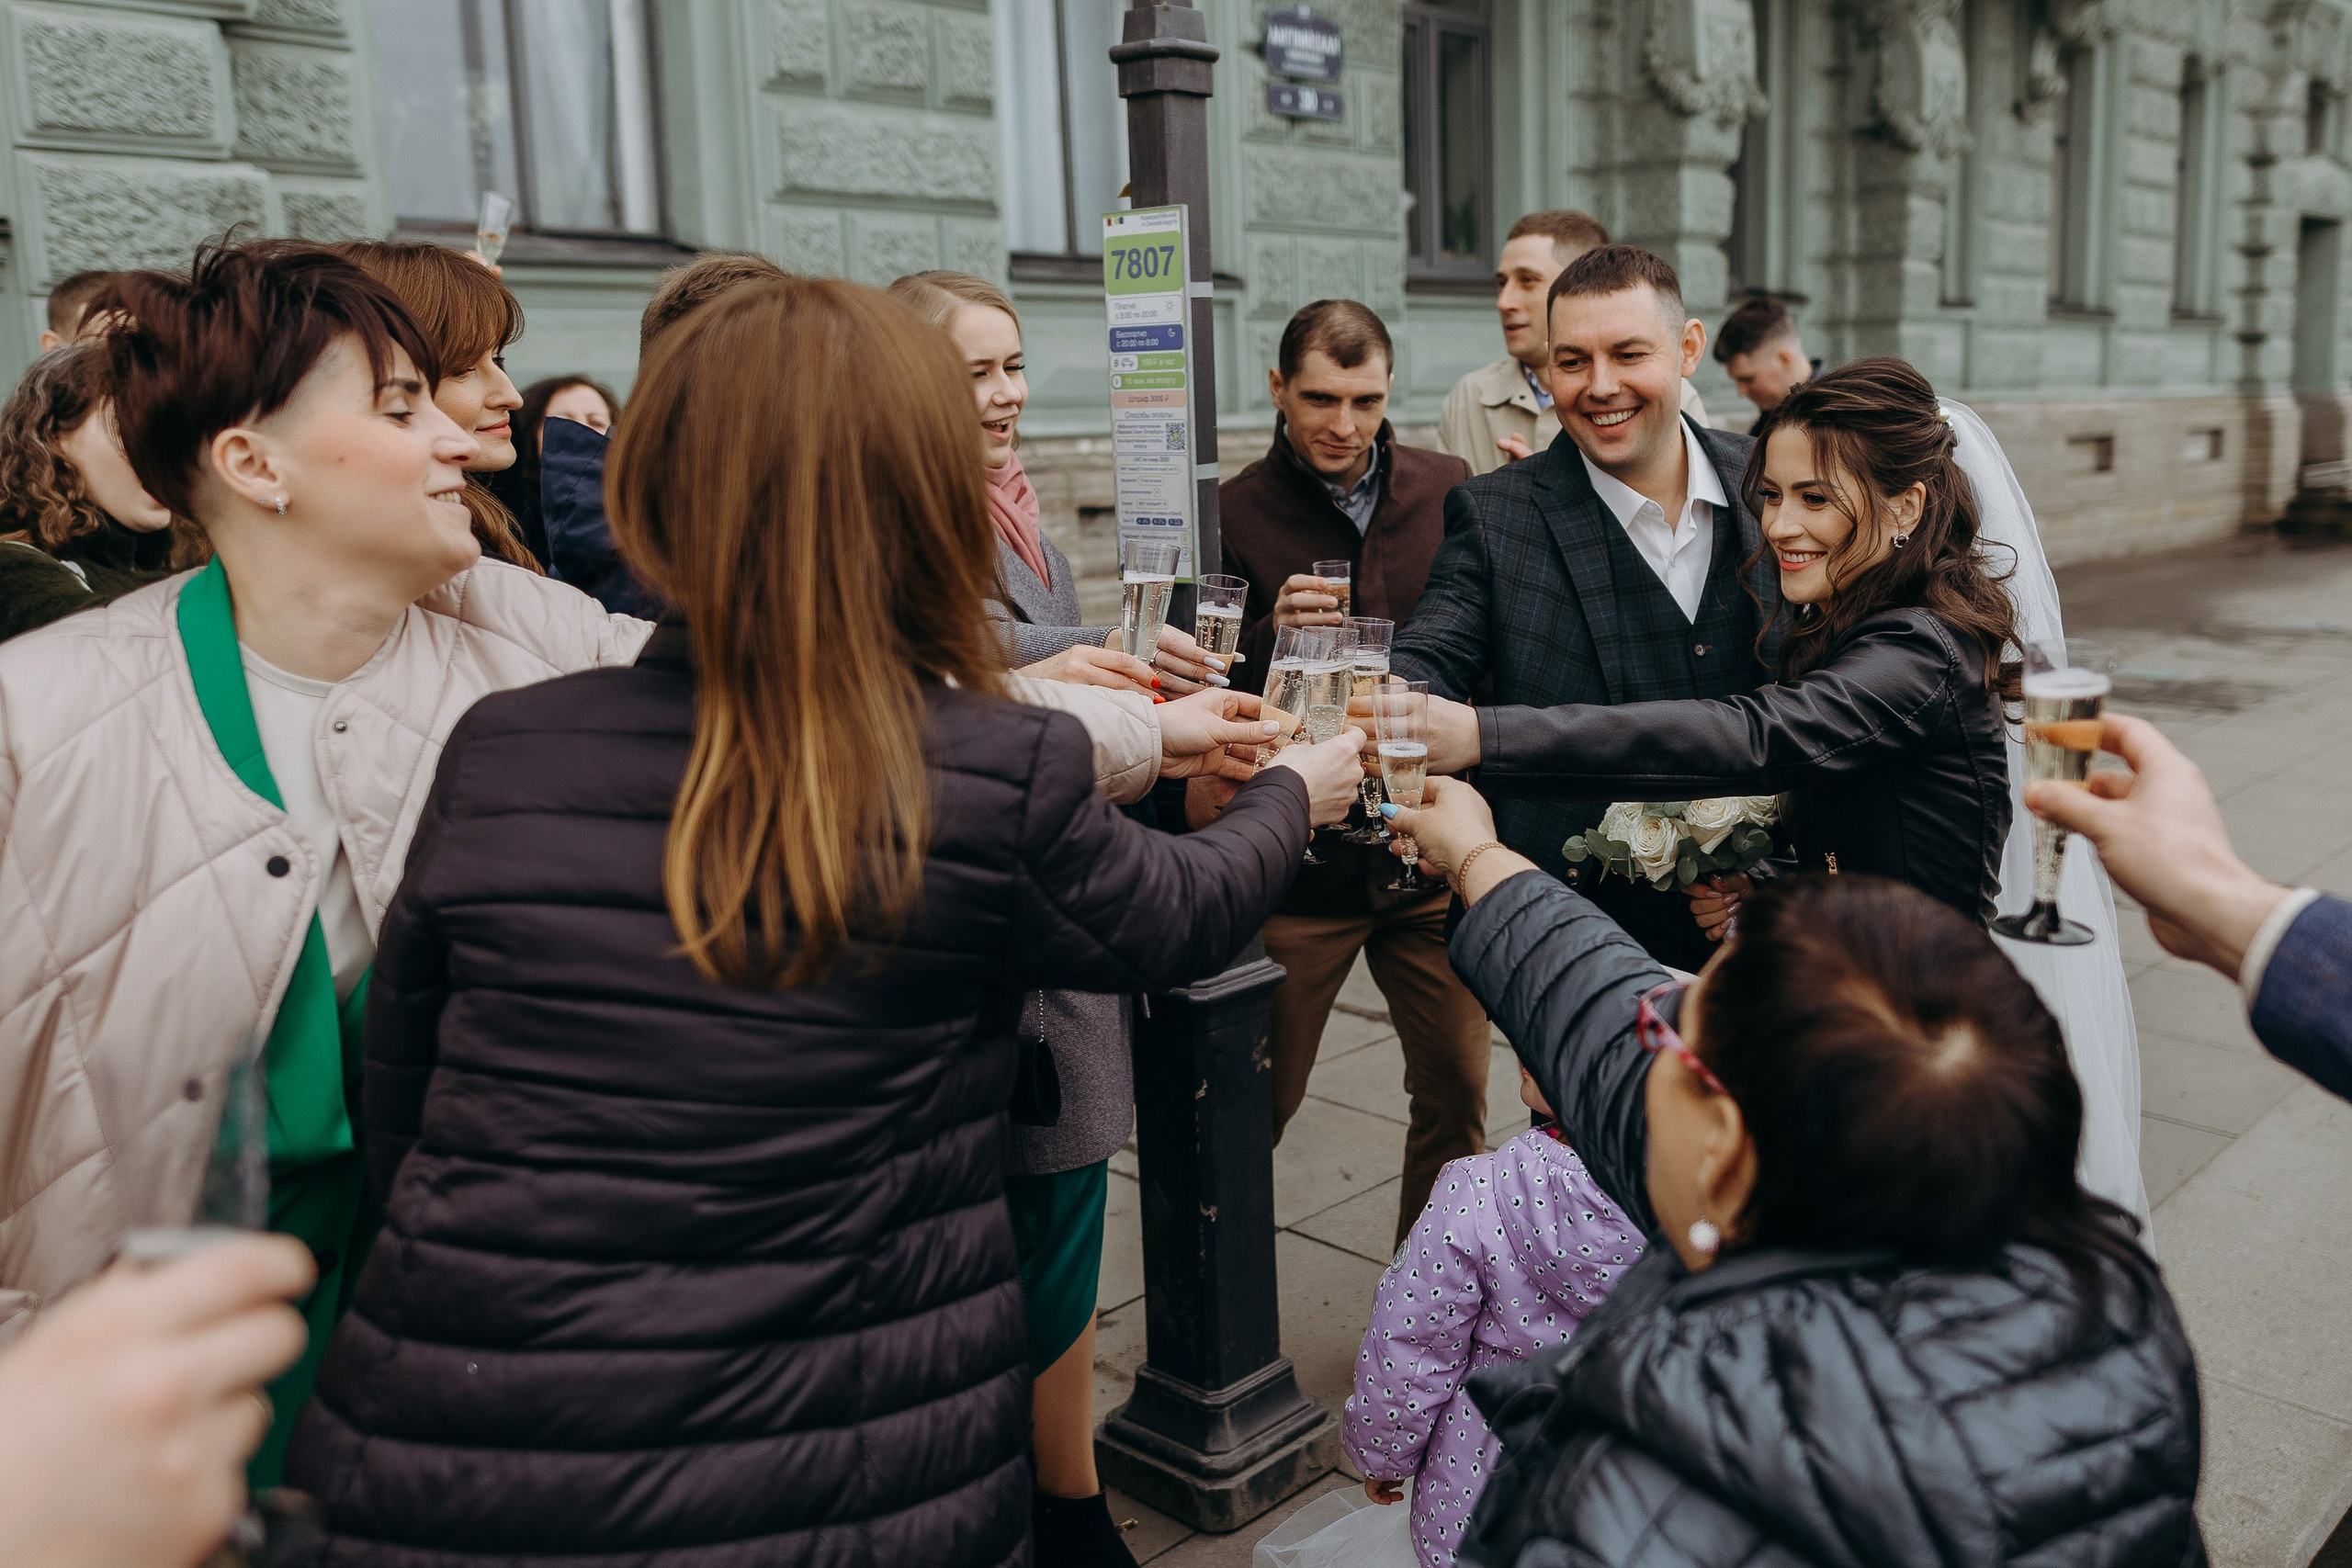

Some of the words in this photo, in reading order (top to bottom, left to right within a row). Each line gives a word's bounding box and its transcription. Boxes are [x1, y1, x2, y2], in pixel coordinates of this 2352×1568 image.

[1111, 245, 1175, 280] 7807
[1114, 330, 1148, 339] Бесплатно
[1128, 395, 1148, 403] Штраф
